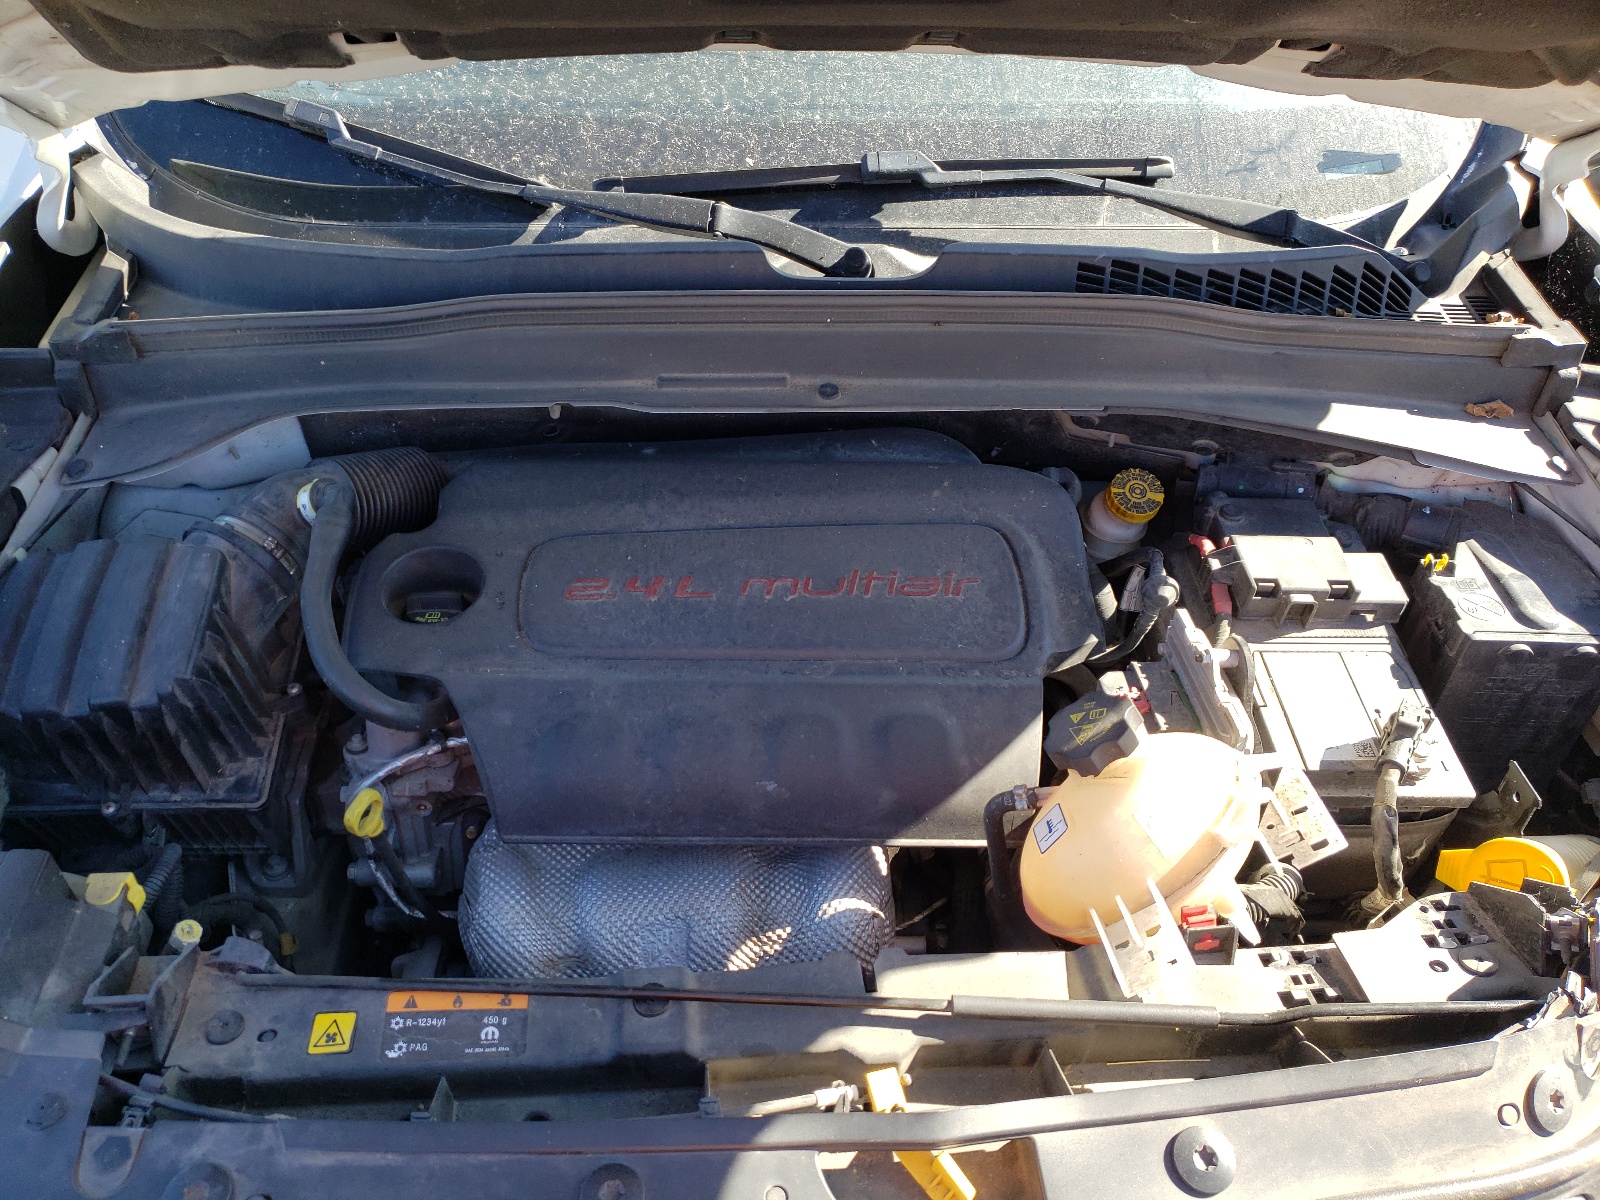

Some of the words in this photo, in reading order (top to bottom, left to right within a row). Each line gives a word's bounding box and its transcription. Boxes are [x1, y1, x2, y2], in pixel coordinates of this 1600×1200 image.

[740, 569, 980, 599] multiair
[406, 1016, 447, 1028] R-1234yf
[483, 1015, 499, 1024] 450
[502, 1016, 508, 1025] g
[409, 1042, 428, 1051] PAG
